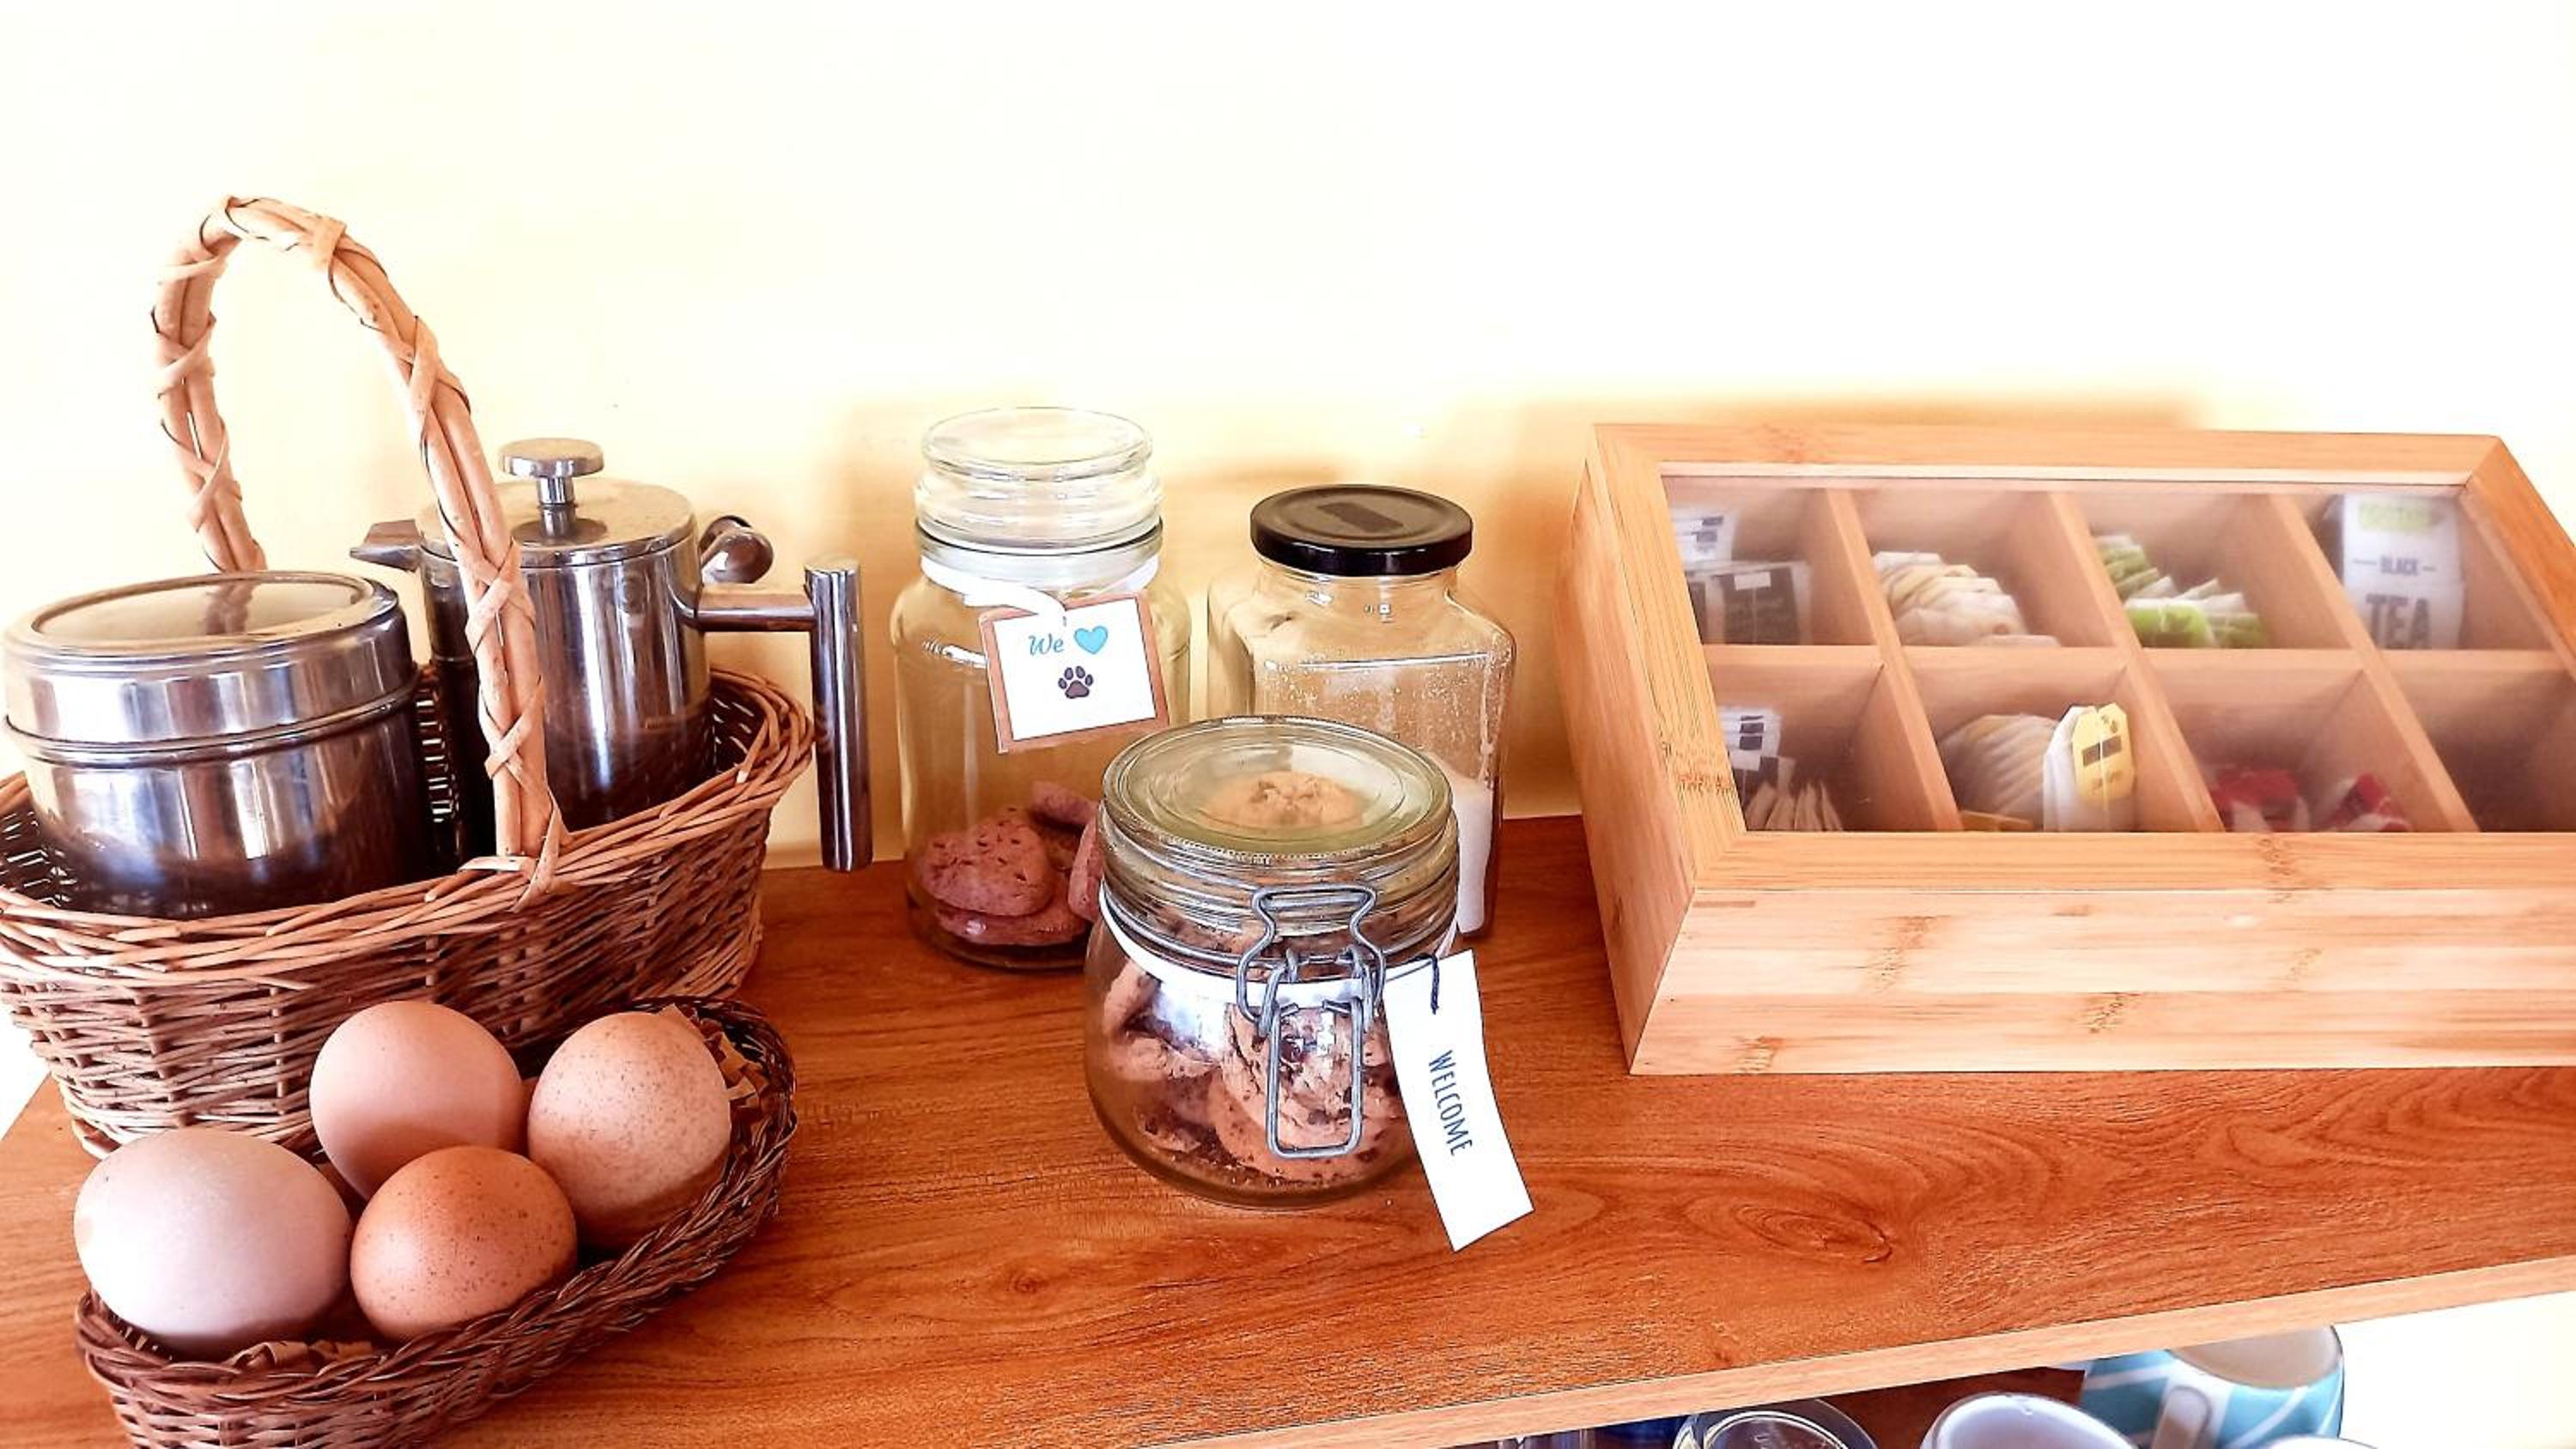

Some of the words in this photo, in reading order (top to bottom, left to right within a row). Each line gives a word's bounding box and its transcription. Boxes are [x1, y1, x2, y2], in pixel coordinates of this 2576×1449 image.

[2379, 555, 2420, 577] BLACK
[2366, 592, 2433, 650] TEA
[1028, 632, 1065, 656] We
[1428, 1049, 1473, 1156] WELCOME
